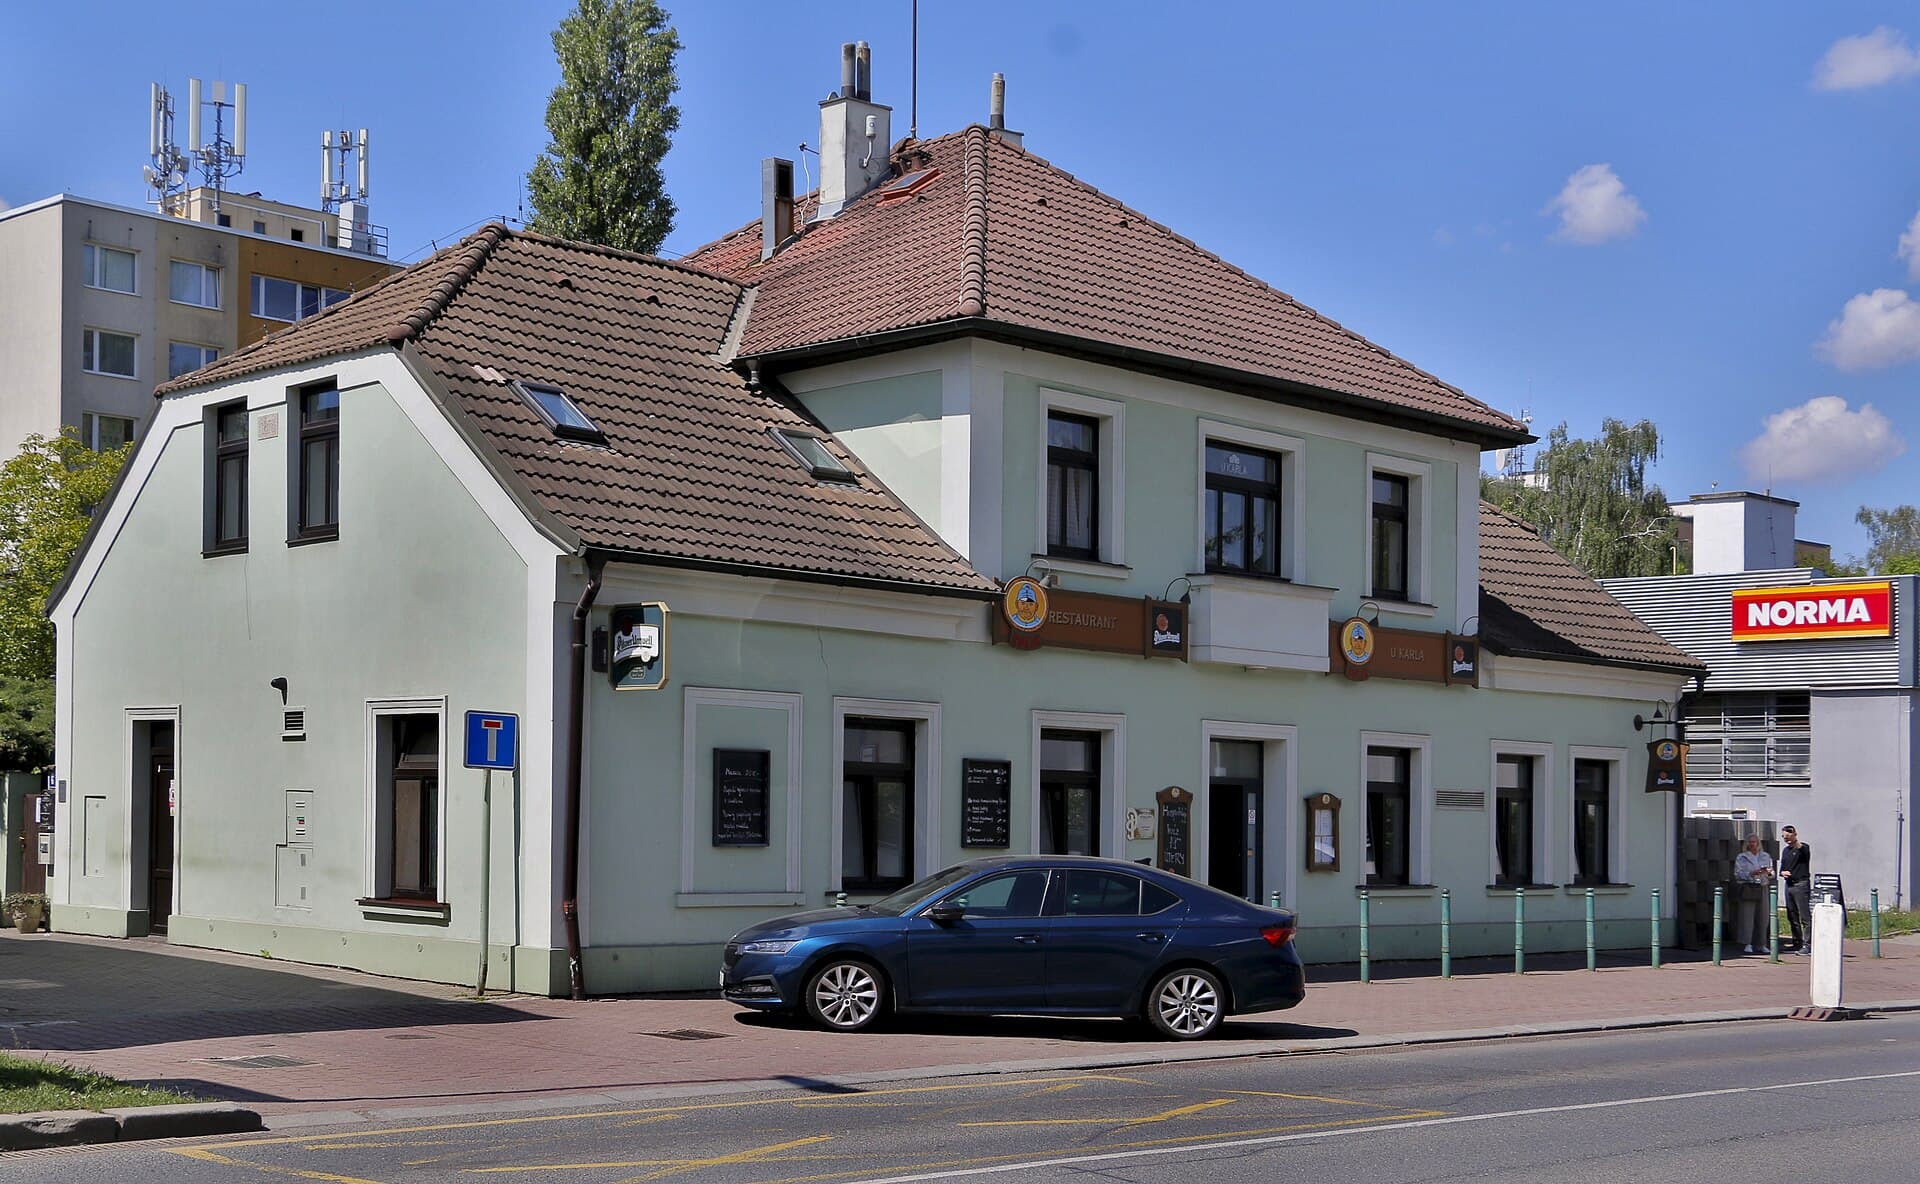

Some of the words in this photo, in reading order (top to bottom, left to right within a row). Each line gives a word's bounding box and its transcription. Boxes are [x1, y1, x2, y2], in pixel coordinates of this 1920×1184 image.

[1048, 610, 1118, 629] RESTAURANT
[1747, 597, 1871, 627] NORMA
[1390, 647, 1397, 658] U
[1399, 648, 1425, 661] KARLA
